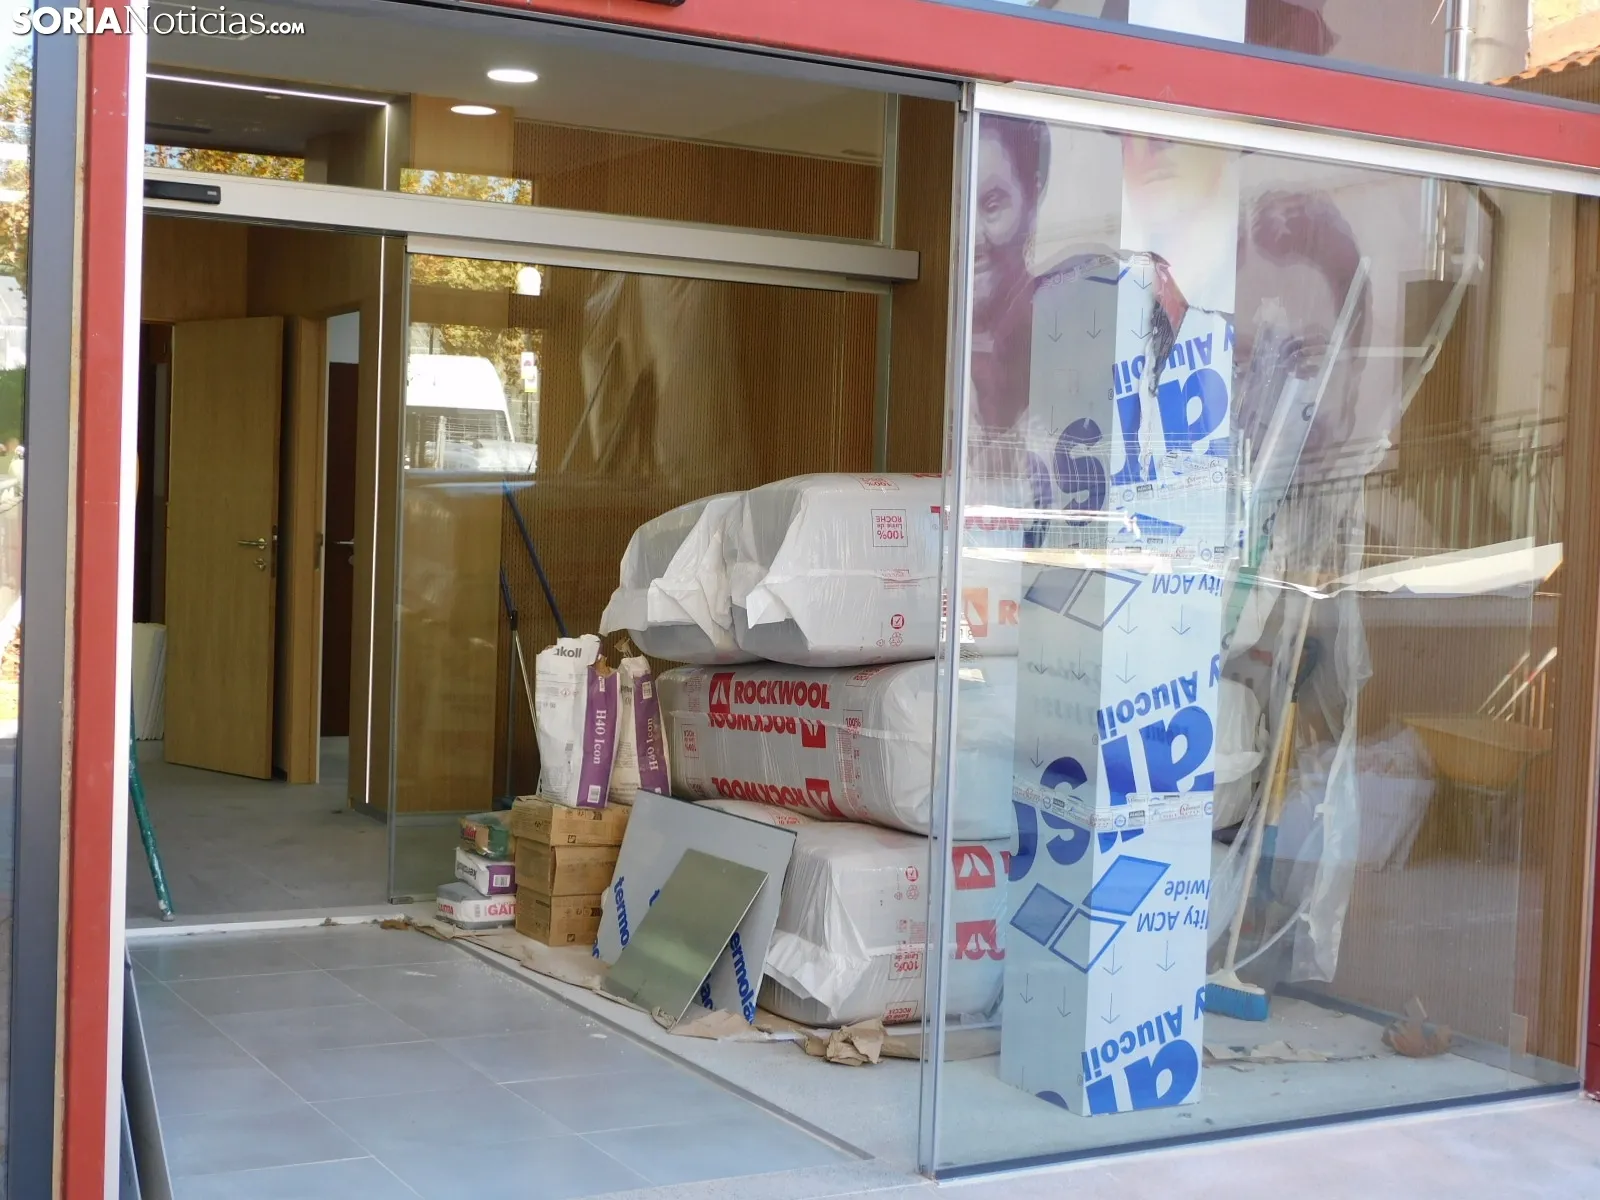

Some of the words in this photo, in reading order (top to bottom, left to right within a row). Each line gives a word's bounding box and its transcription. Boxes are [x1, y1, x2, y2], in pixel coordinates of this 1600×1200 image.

[1111, 332, 1213, 396] Aluoil
[875, 515, 902, 523] ROCHE
[876, 530, 904, 540] 100%
[1152, 573, 1193, 594] ACM
[734, 680, 830, 710] ROCKWOOL
[595, 709, 607, 735] H40
[613, 876, 630, 948] termo
[1136, 911, 1180, 933] ACM
[730, 931, 756, 1024] ermola
